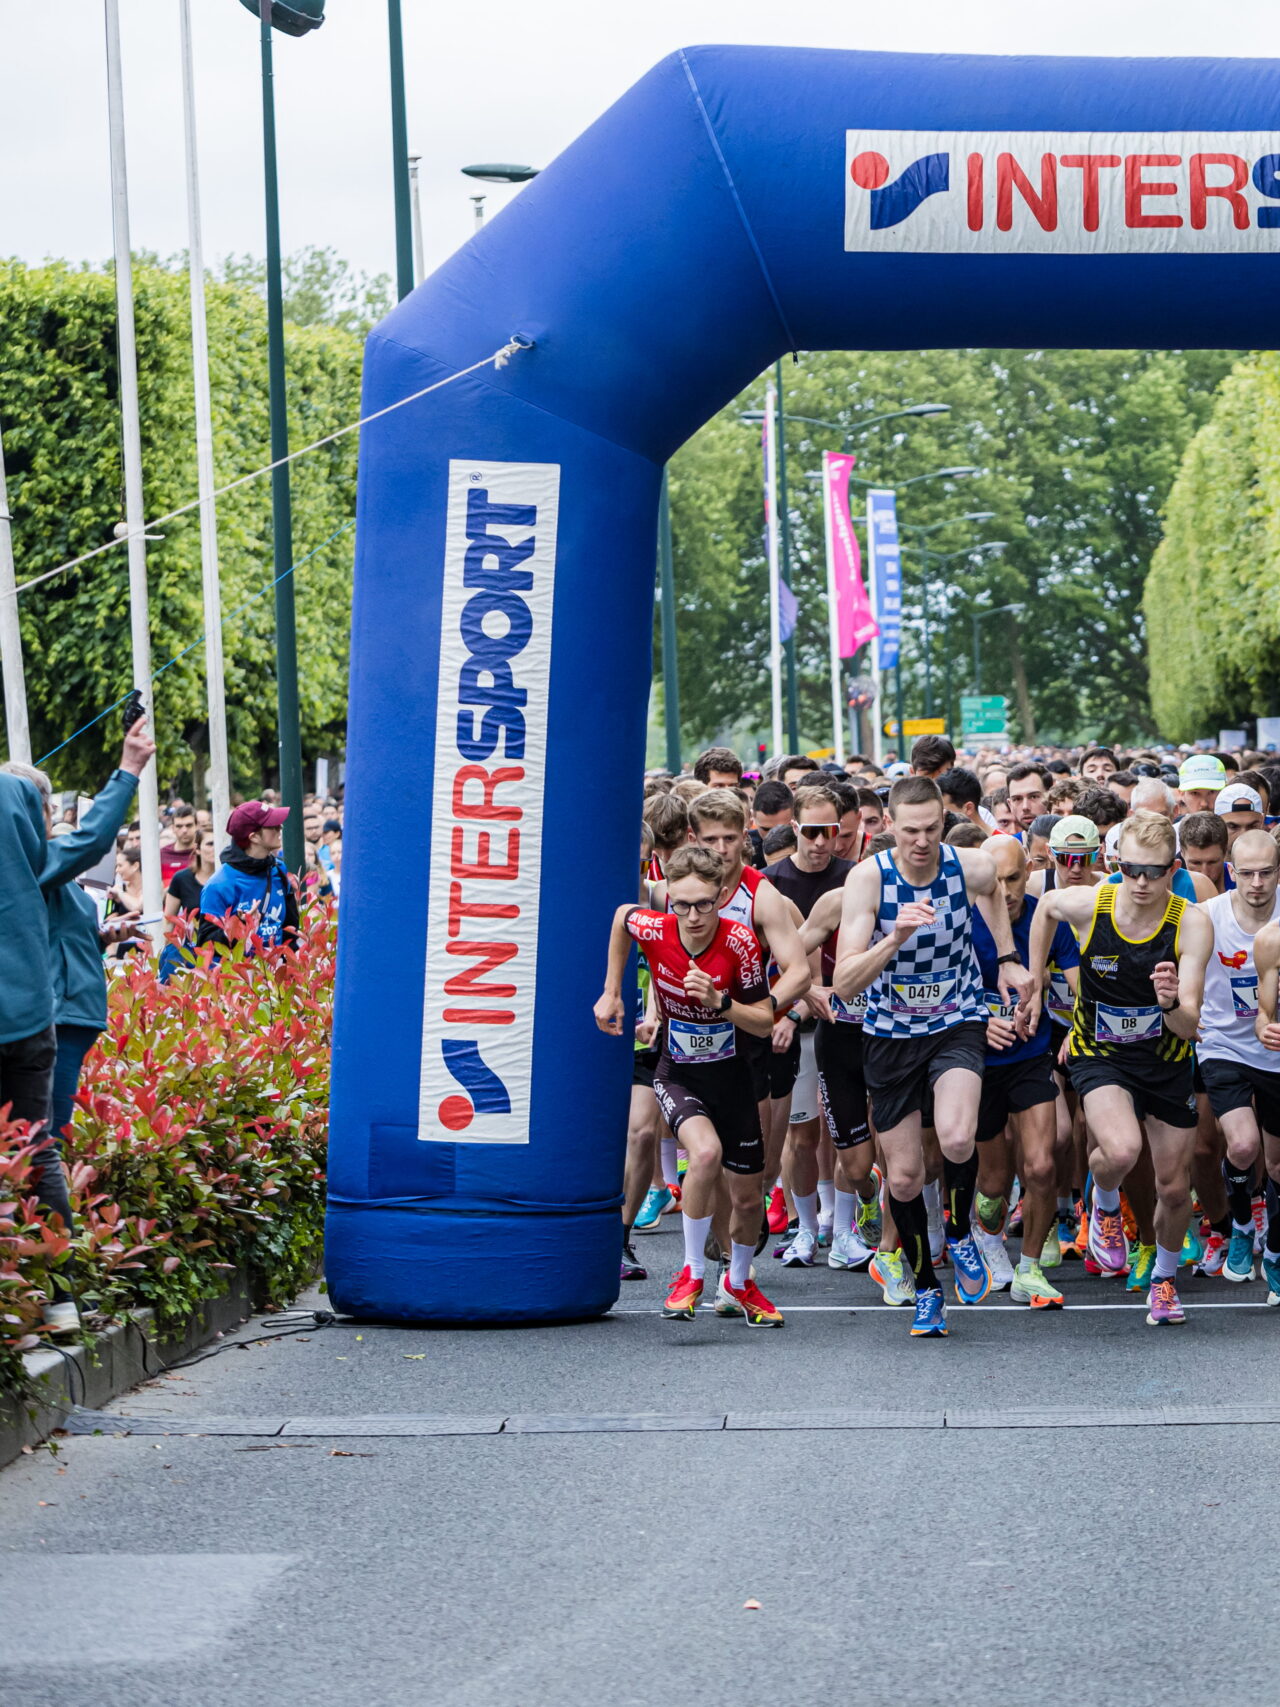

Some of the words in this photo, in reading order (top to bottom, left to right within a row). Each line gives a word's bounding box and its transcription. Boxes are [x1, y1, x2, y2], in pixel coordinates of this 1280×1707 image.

[725, 935, 753, 989] TRIATHLON
[730, 924, 756, 951] USM
[751, 953, 763, 986] VIRE
[908, 984, 940, 999] D479
[1121, 1017, 1137, 1030] D8
[690, 1035, 714, 1048] D28
